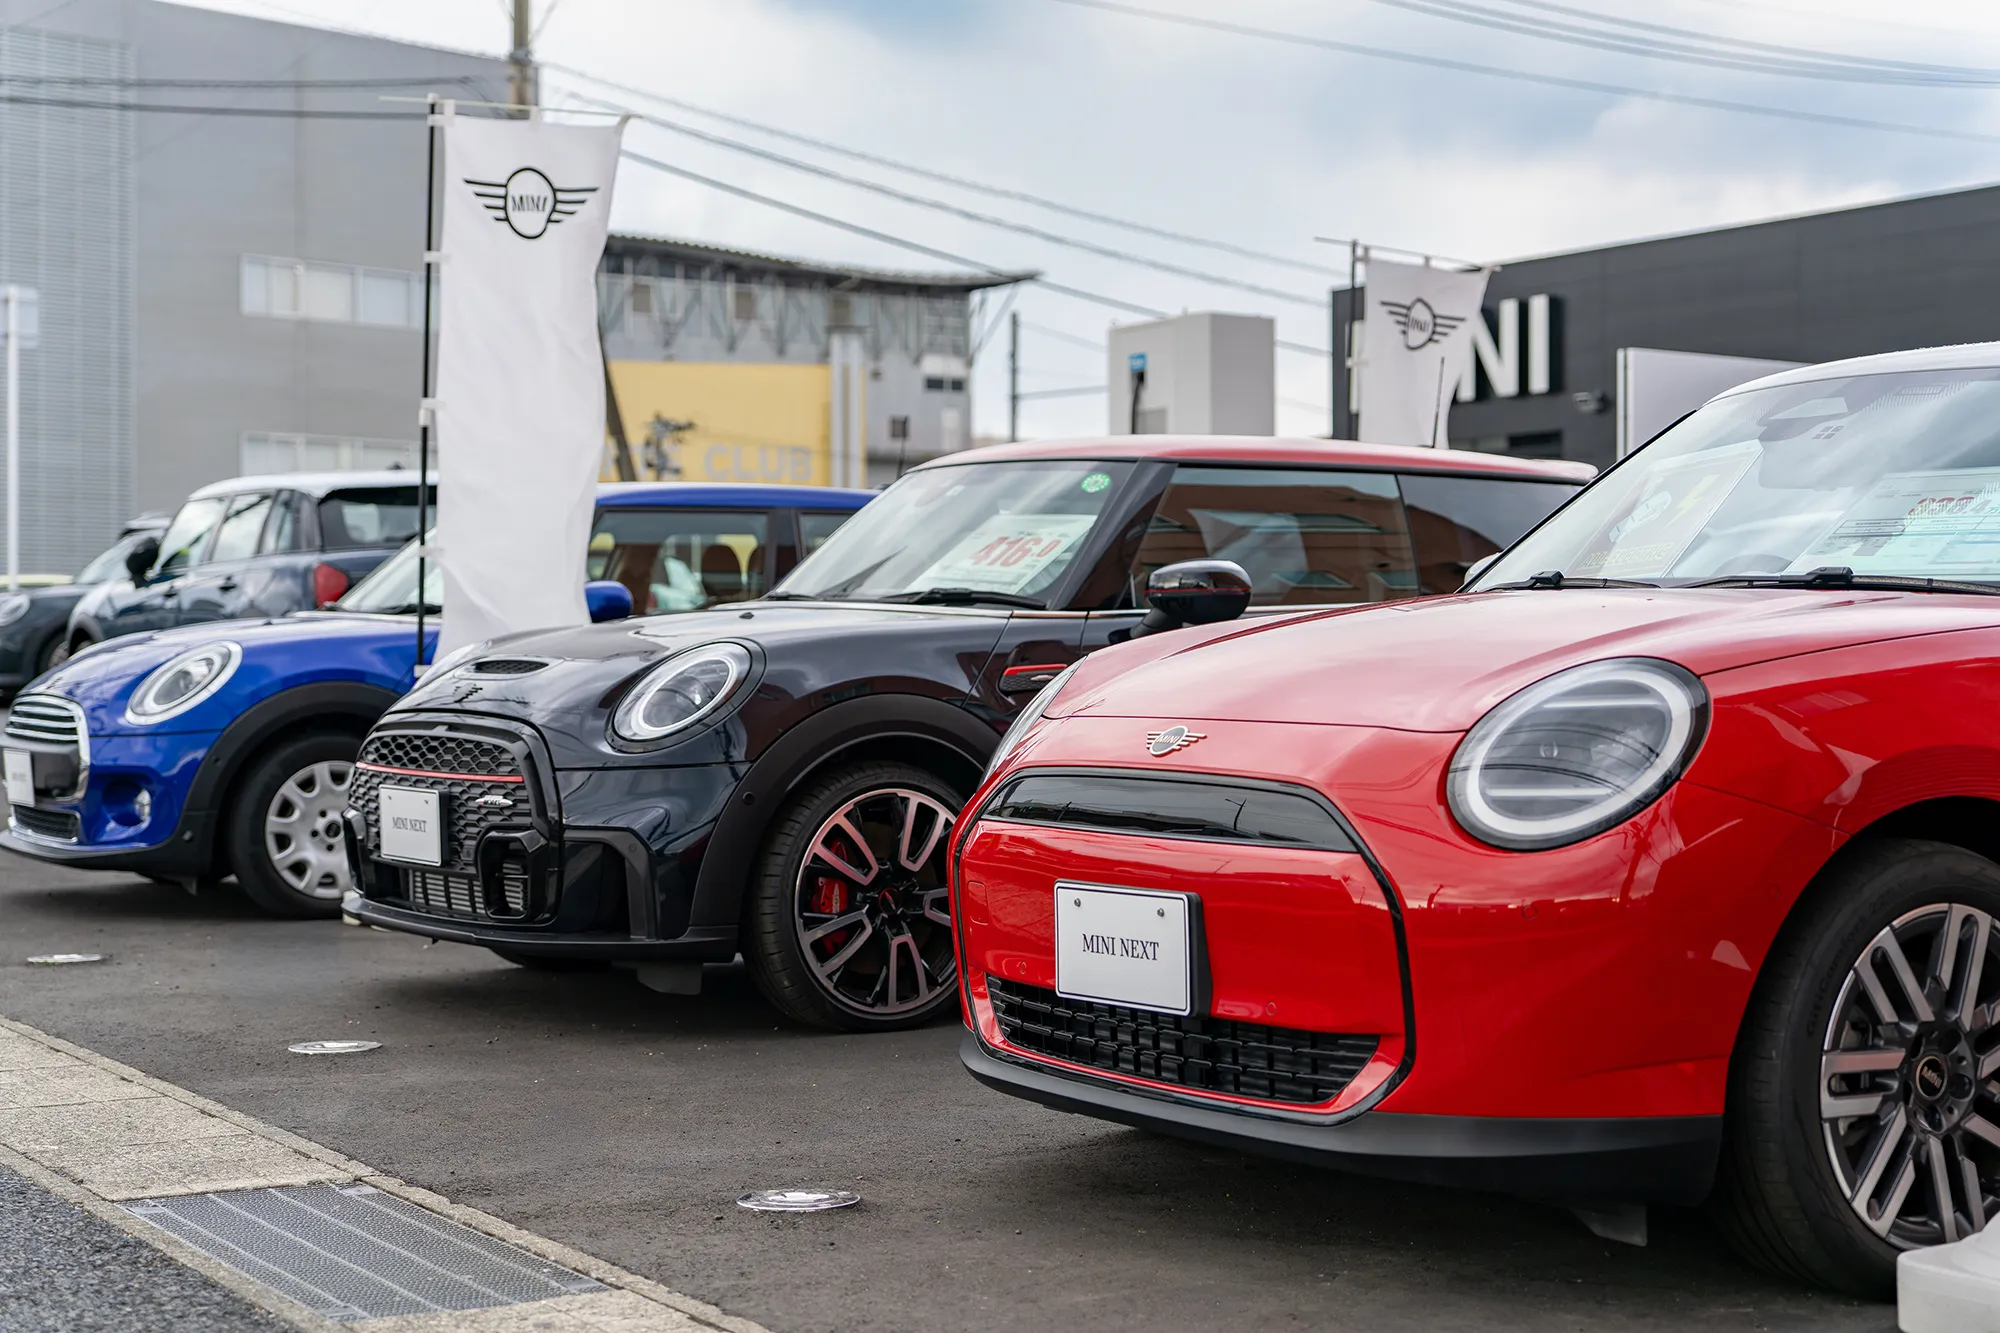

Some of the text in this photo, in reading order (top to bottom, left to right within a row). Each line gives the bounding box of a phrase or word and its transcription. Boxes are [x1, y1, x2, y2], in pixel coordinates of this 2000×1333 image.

[511, 195, 547, 212] MINI
[703, 443, 814, 481] CLUB
[392, 816, 427, 833] MINI NEXT
[1082, 933, 1159, 961] MINI NEXT
